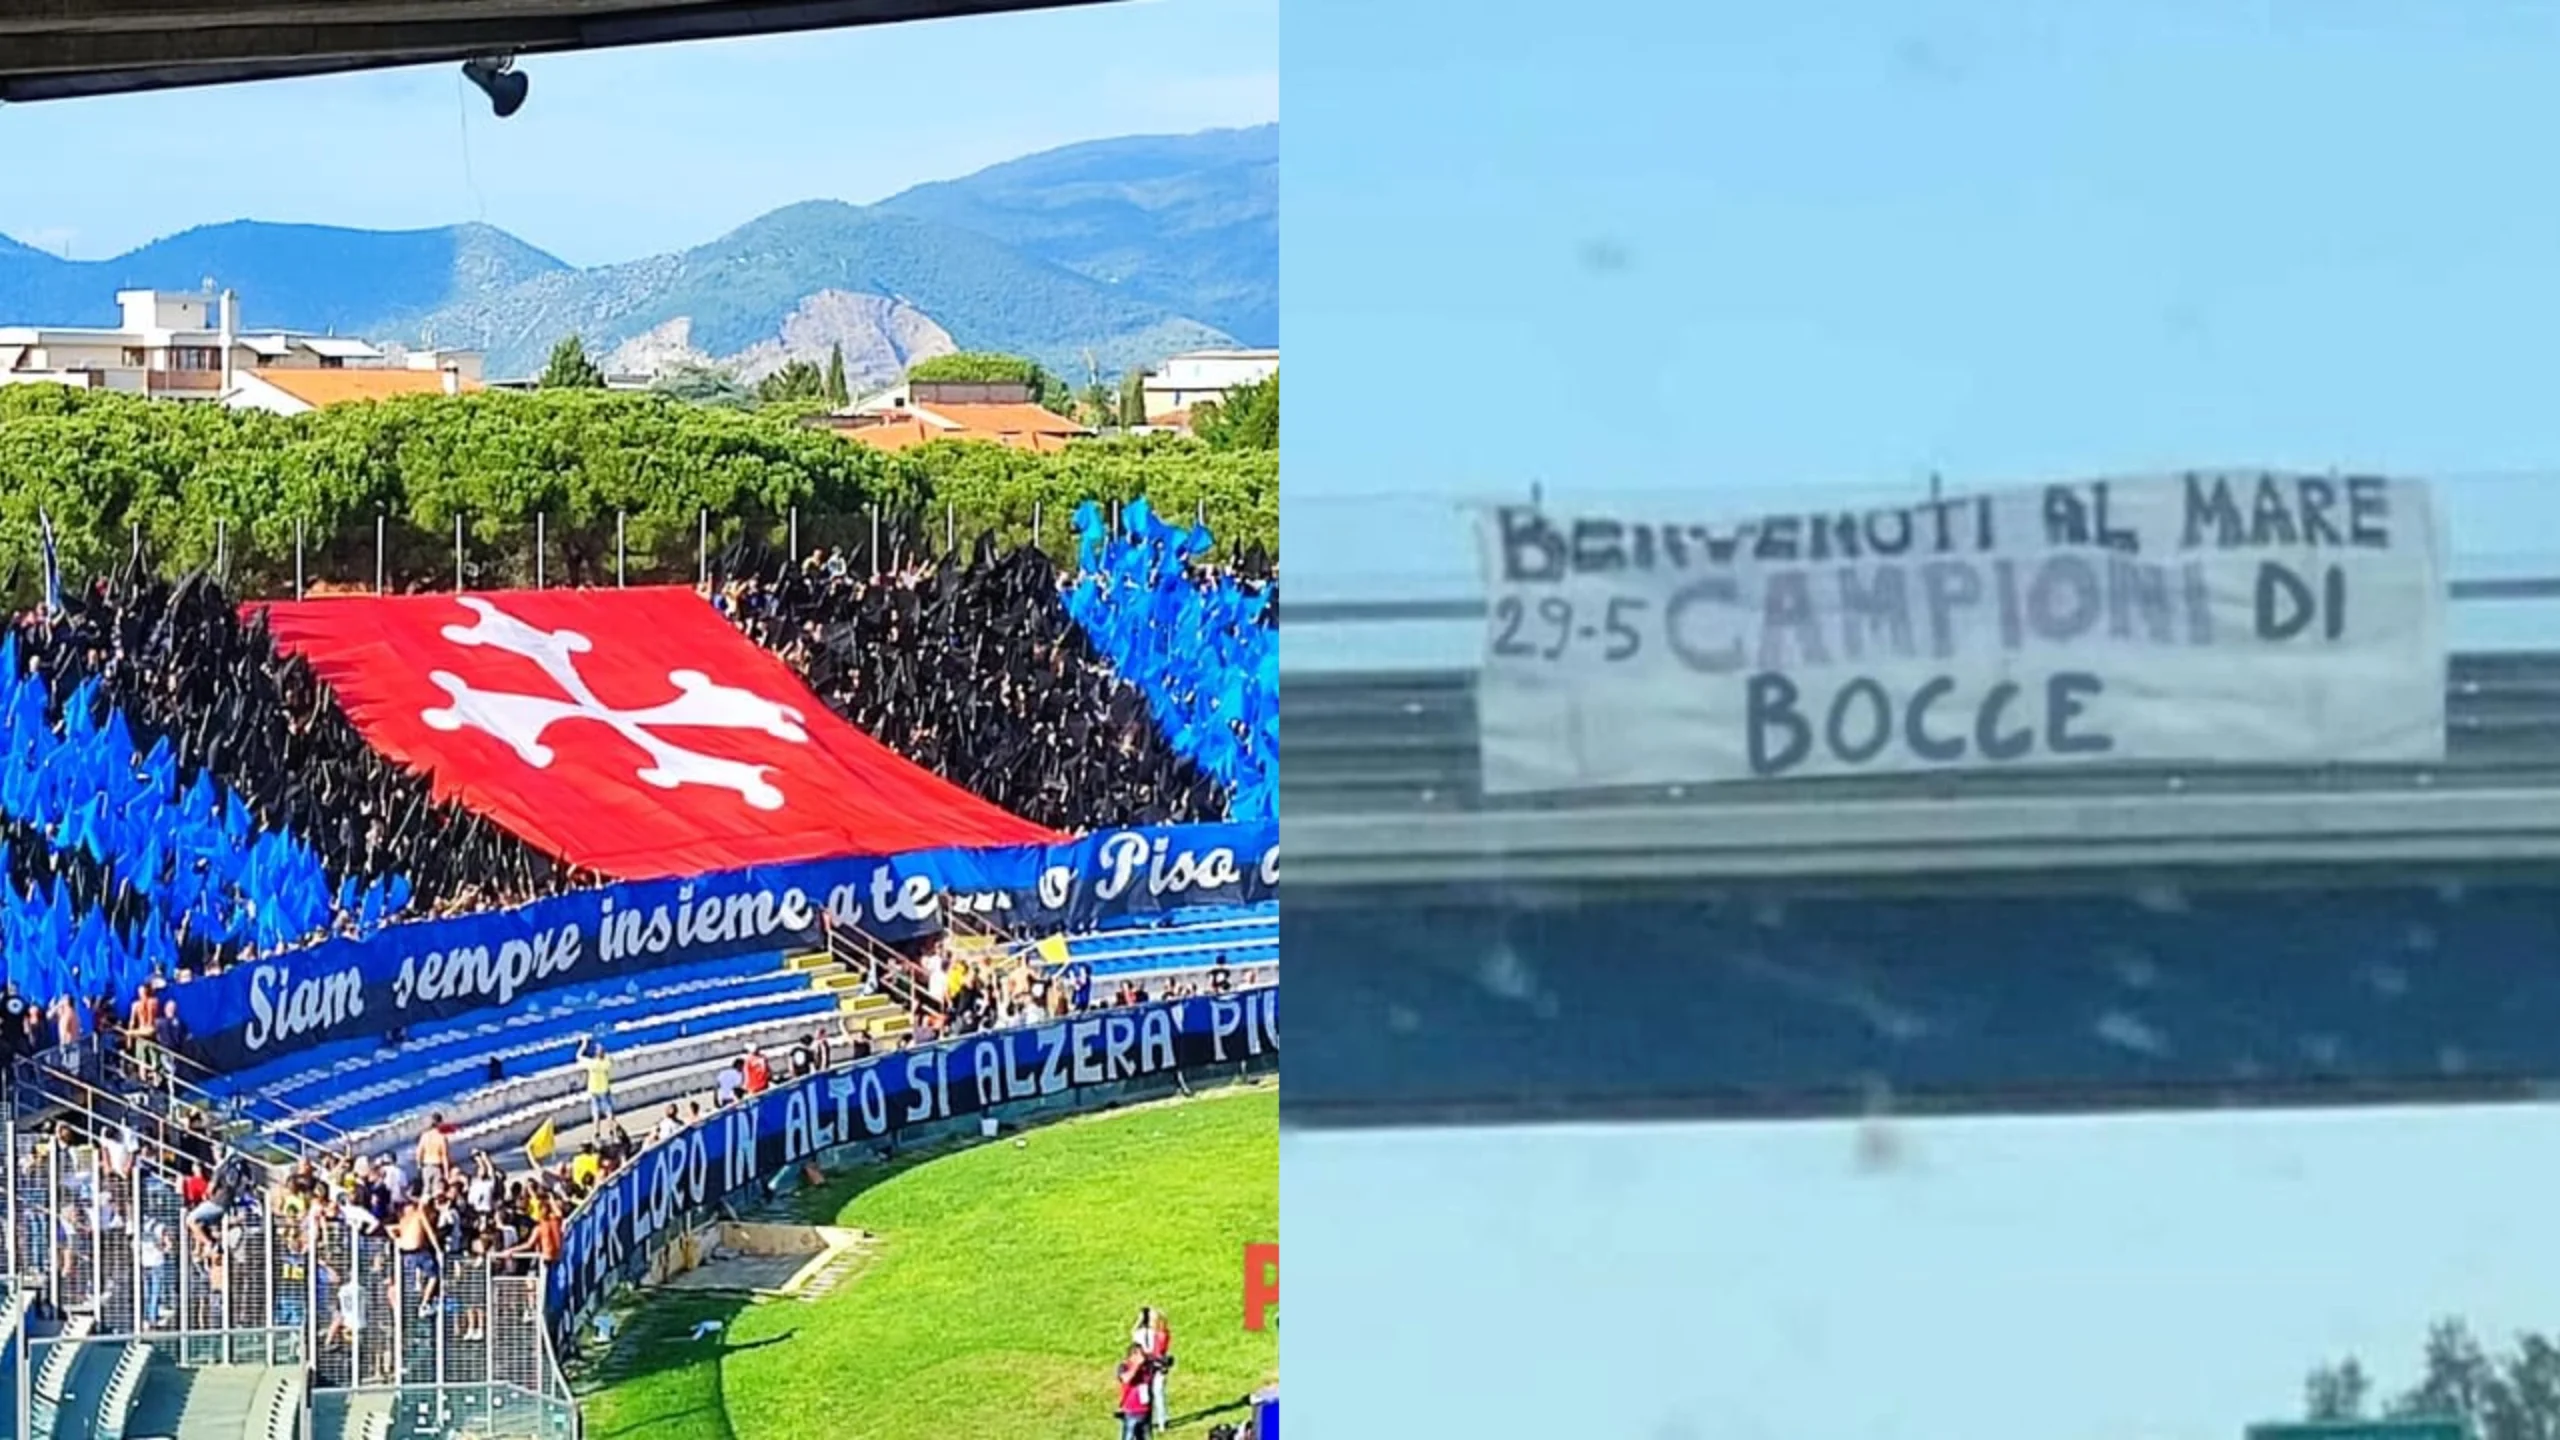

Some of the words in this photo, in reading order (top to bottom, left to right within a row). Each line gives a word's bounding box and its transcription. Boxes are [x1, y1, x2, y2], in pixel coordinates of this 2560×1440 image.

[2043, 480, 2140, 553] AL
[2181, 471, 2391, 549] MARE
[1494, 596, 1648, 660] 29-5
[1665, 554, 2213, 673] CAMPIONI
[2255, 560, 2346, 641] DI
[1746, 671, 2113, 776] BOCCE
[245, 965, 364, 1049] Siam
[393, 922, 582, 1008] sempre
[600, 884, 814, 961] insieme
[828, 883, 863, 926] a
[870, 865, 939, 923] te
[633, 1129, 708, 1245] LORO
[725, 1107, 761, 1192] IN
[785, 1069, 887, 1162] ALTO
